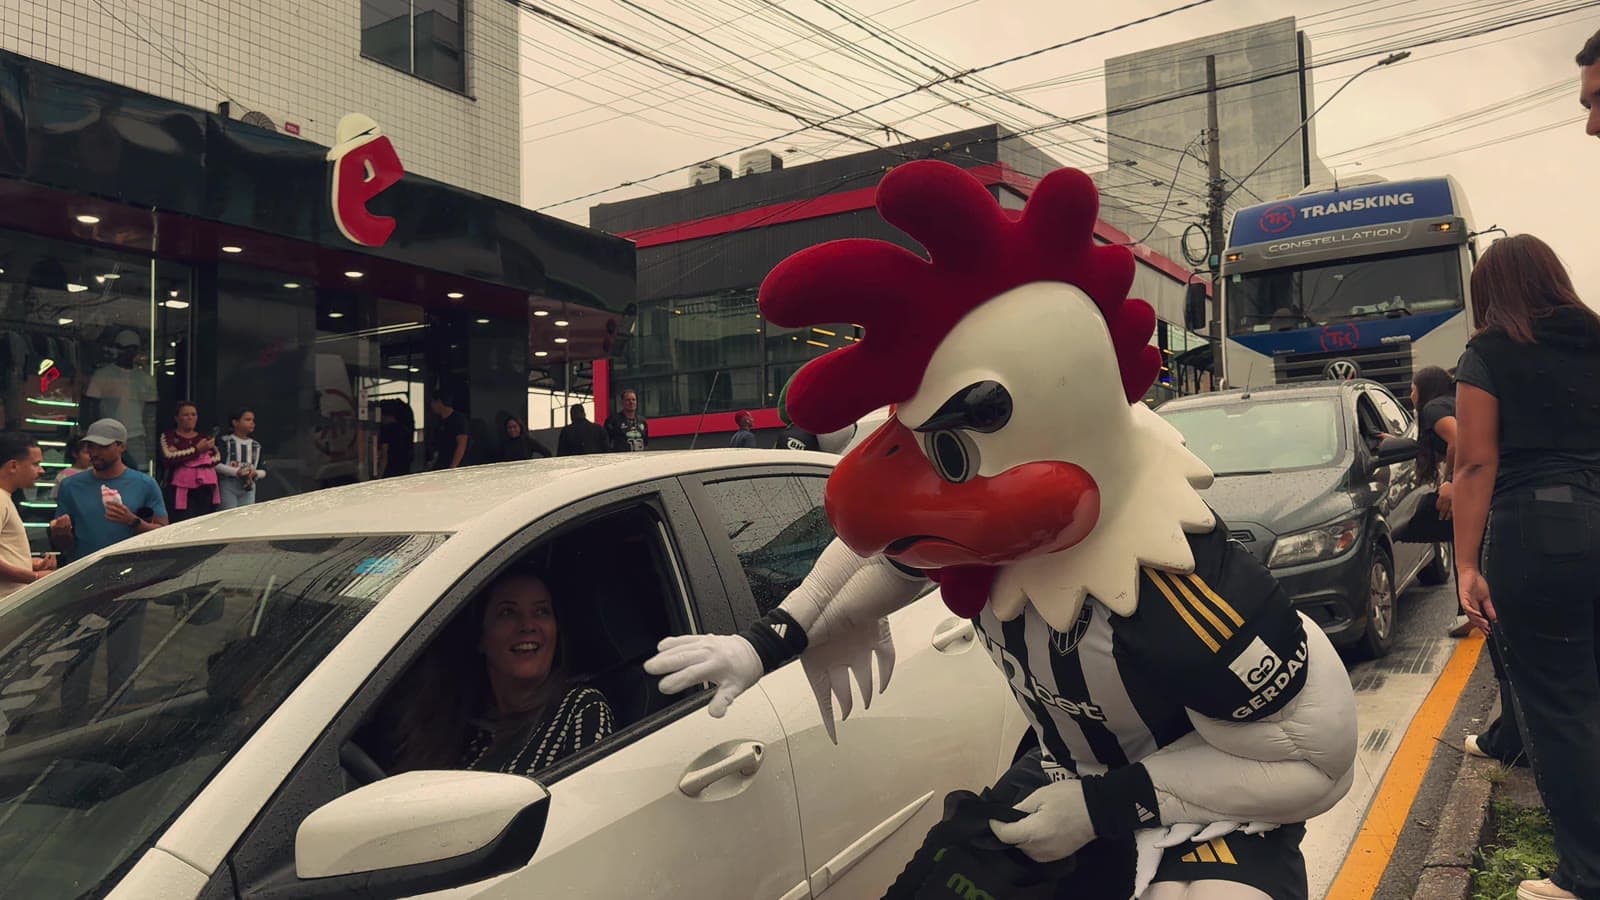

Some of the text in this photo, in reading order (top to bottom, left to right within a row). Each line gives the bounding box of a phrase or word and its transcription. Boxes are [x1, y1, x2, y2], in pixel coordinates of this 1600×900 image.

[1300, 192, 1415, 219] TRANSKING
[1268, 227, 1402, 253] CONSTELLATION
[1232, 640, 1308, 719] GERDAU
